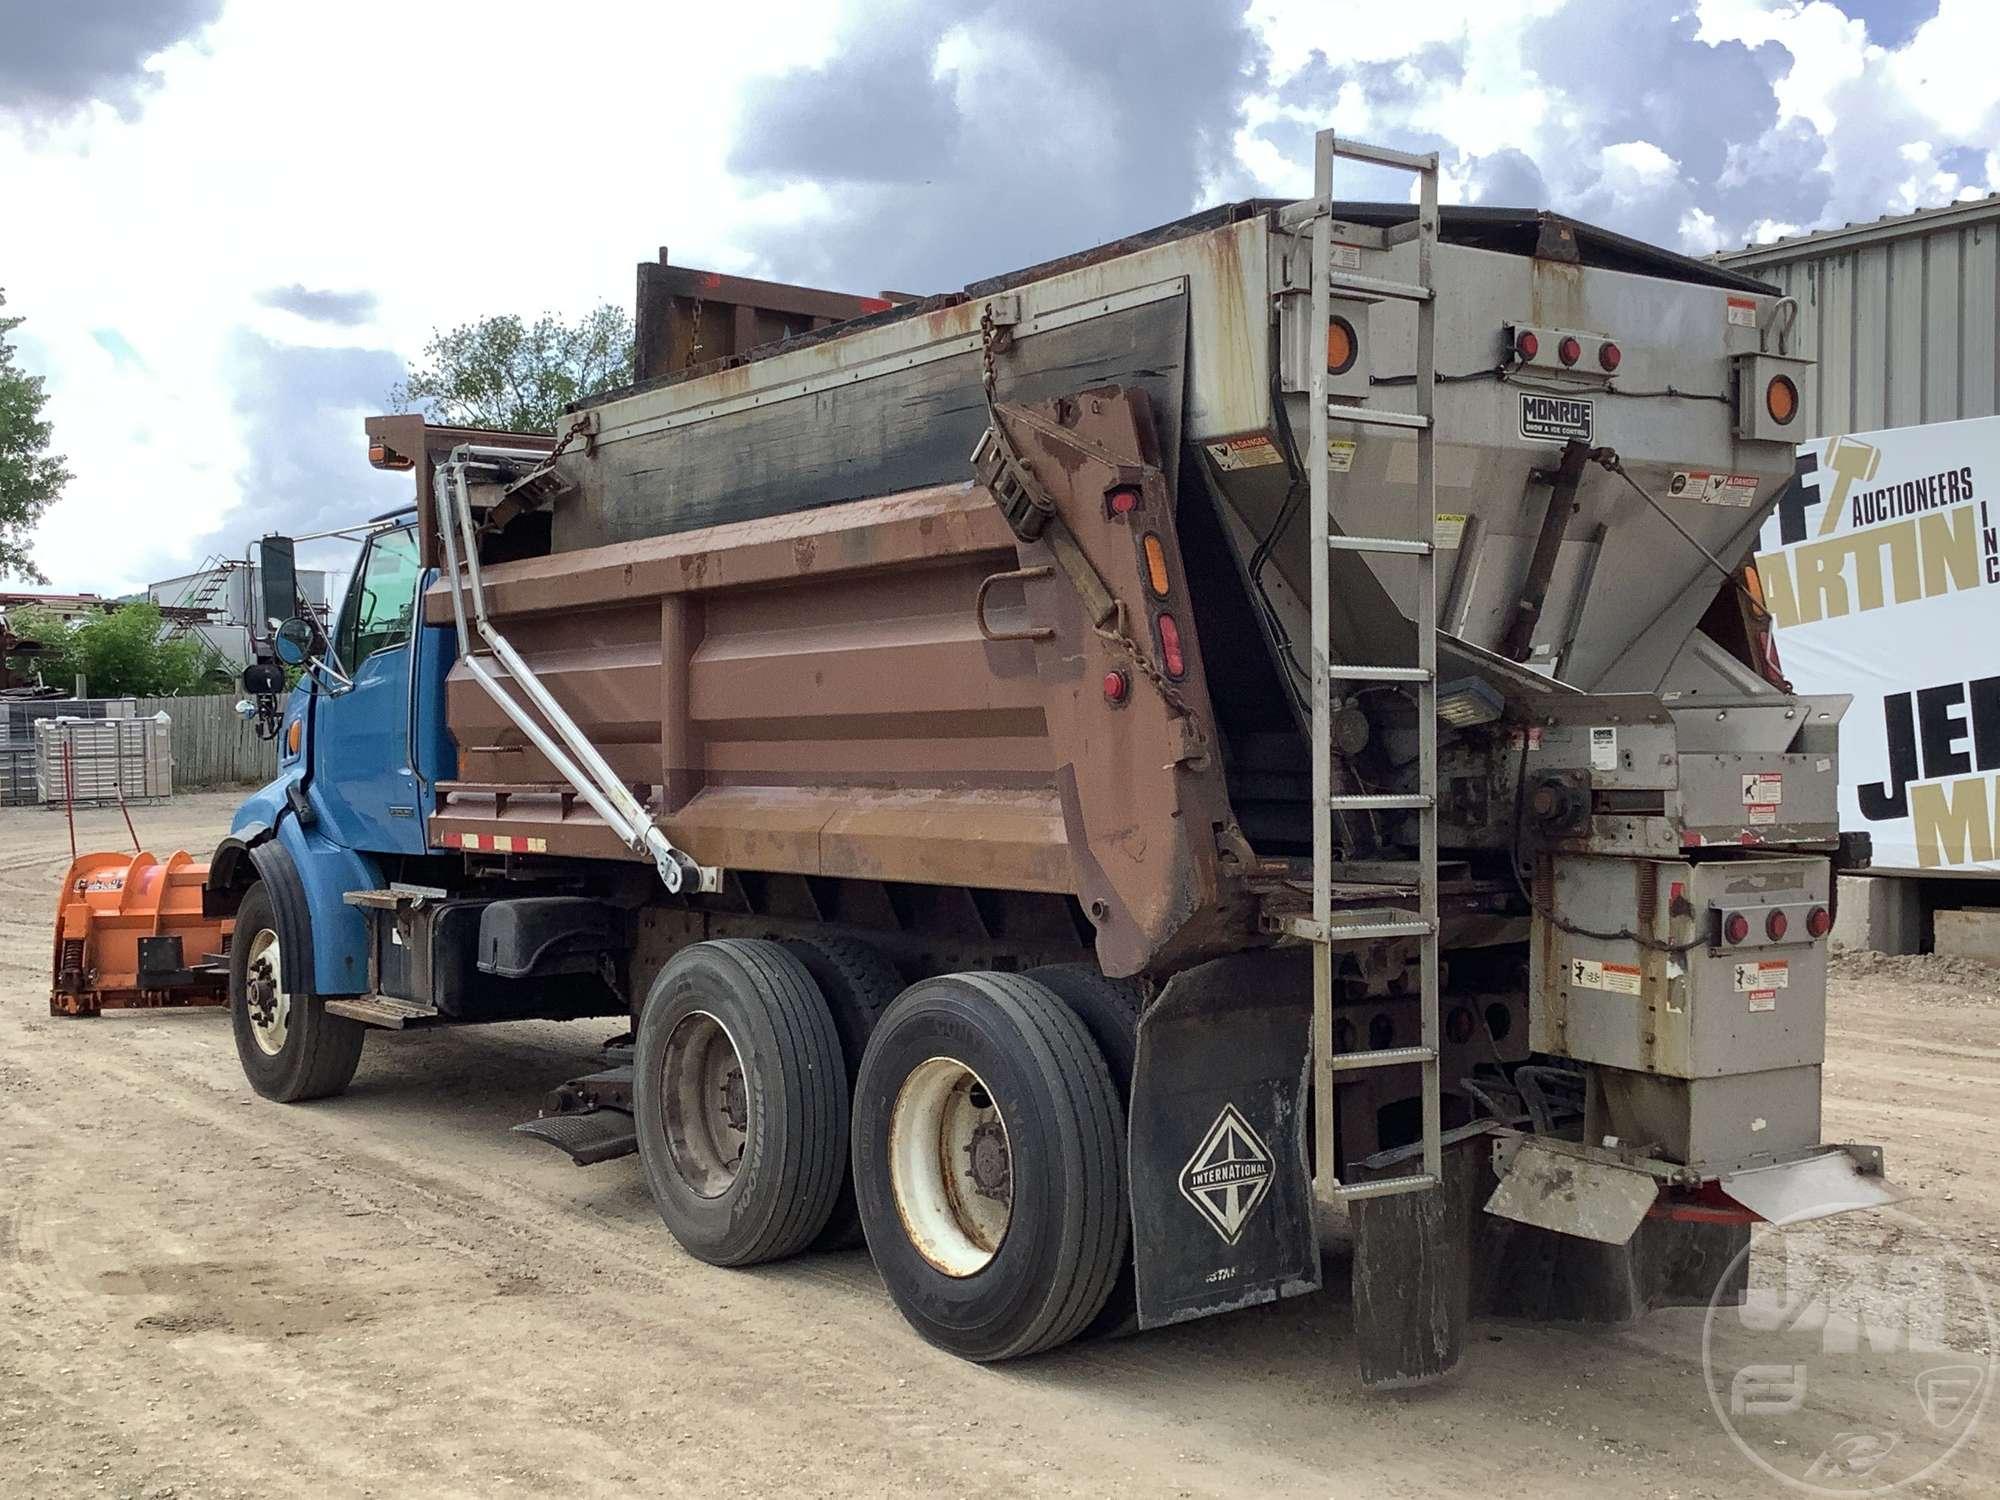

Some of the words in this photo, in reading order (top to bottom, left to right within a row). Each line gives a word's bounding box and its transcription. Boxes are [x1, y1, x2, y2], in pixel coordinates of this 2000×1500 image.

[1523, 397, 1590, 423] MONROE
[1853, 466, 1973, 528] AUCTIONEERS
[1755, 505, 1980, 629] ARTIN
[1981, 501, 2000, 584] INC
[1911, 774, 2000, 867] M
[1193, 1163, 1267, 1185] INTERNATIONAL
